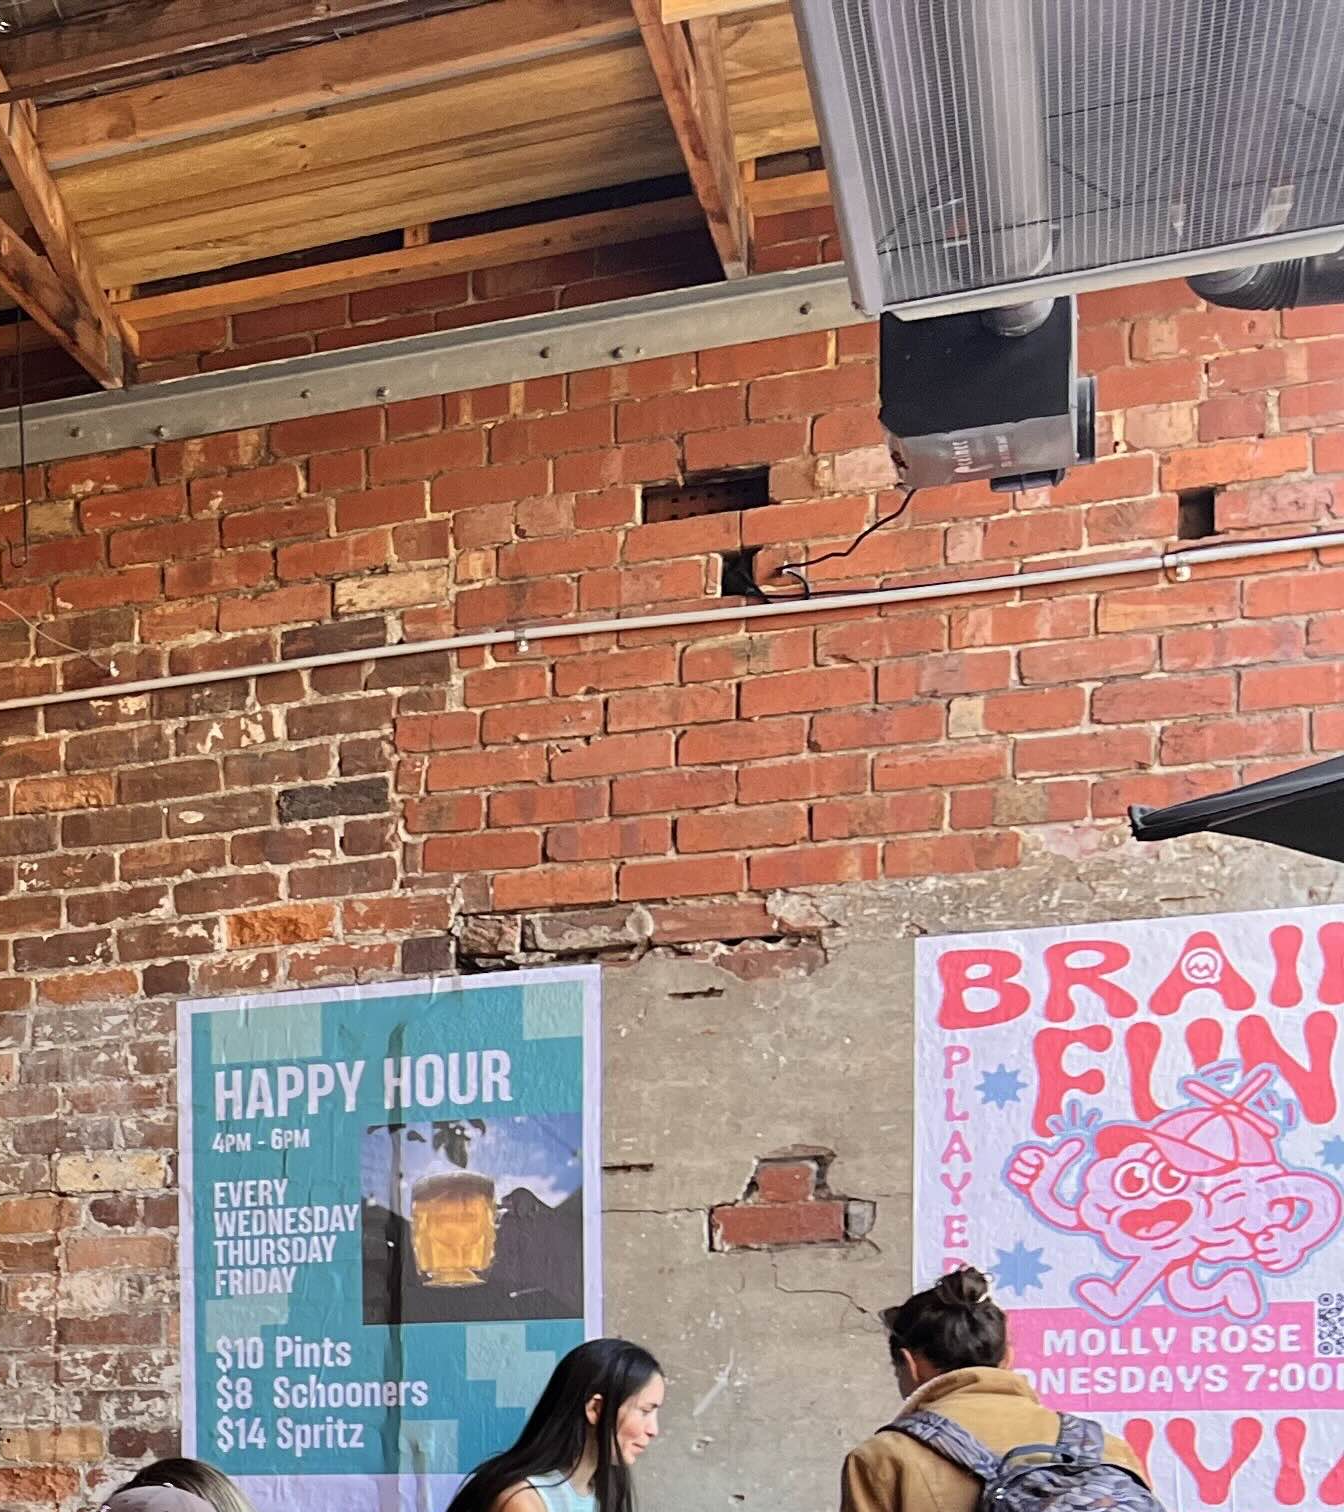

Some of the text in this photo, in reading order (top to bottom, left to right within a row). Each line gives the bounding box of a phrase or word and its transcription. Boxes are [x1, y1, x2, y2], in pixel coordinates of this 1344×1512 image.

[213, 1049, 514, 1122] HAPPY HOUR
[1032, 1008, 1339, 1138] FUN
[212, 1131, 253, 1154] 4PM
[269, 1126, 311, 1150] 6PM
[213, 1179, 289, 1210] EVERY
[213, 1205, 361, 1239] WEDNESDAY
[214, 1234, 338, 1268] THURSDAY
[214, 1265, 298, 1297] FRIDAY
[214, 1334, 352, 1373] $10 Pints
[1042, 1323, 1302, 1357] MOLLY ROSE
[215, 1373, 429, 1412] $8 Schooners
[1241, 1361, 1344, 1393] 7:00
[215, 1415, 366, 1458] $14 Spritz
